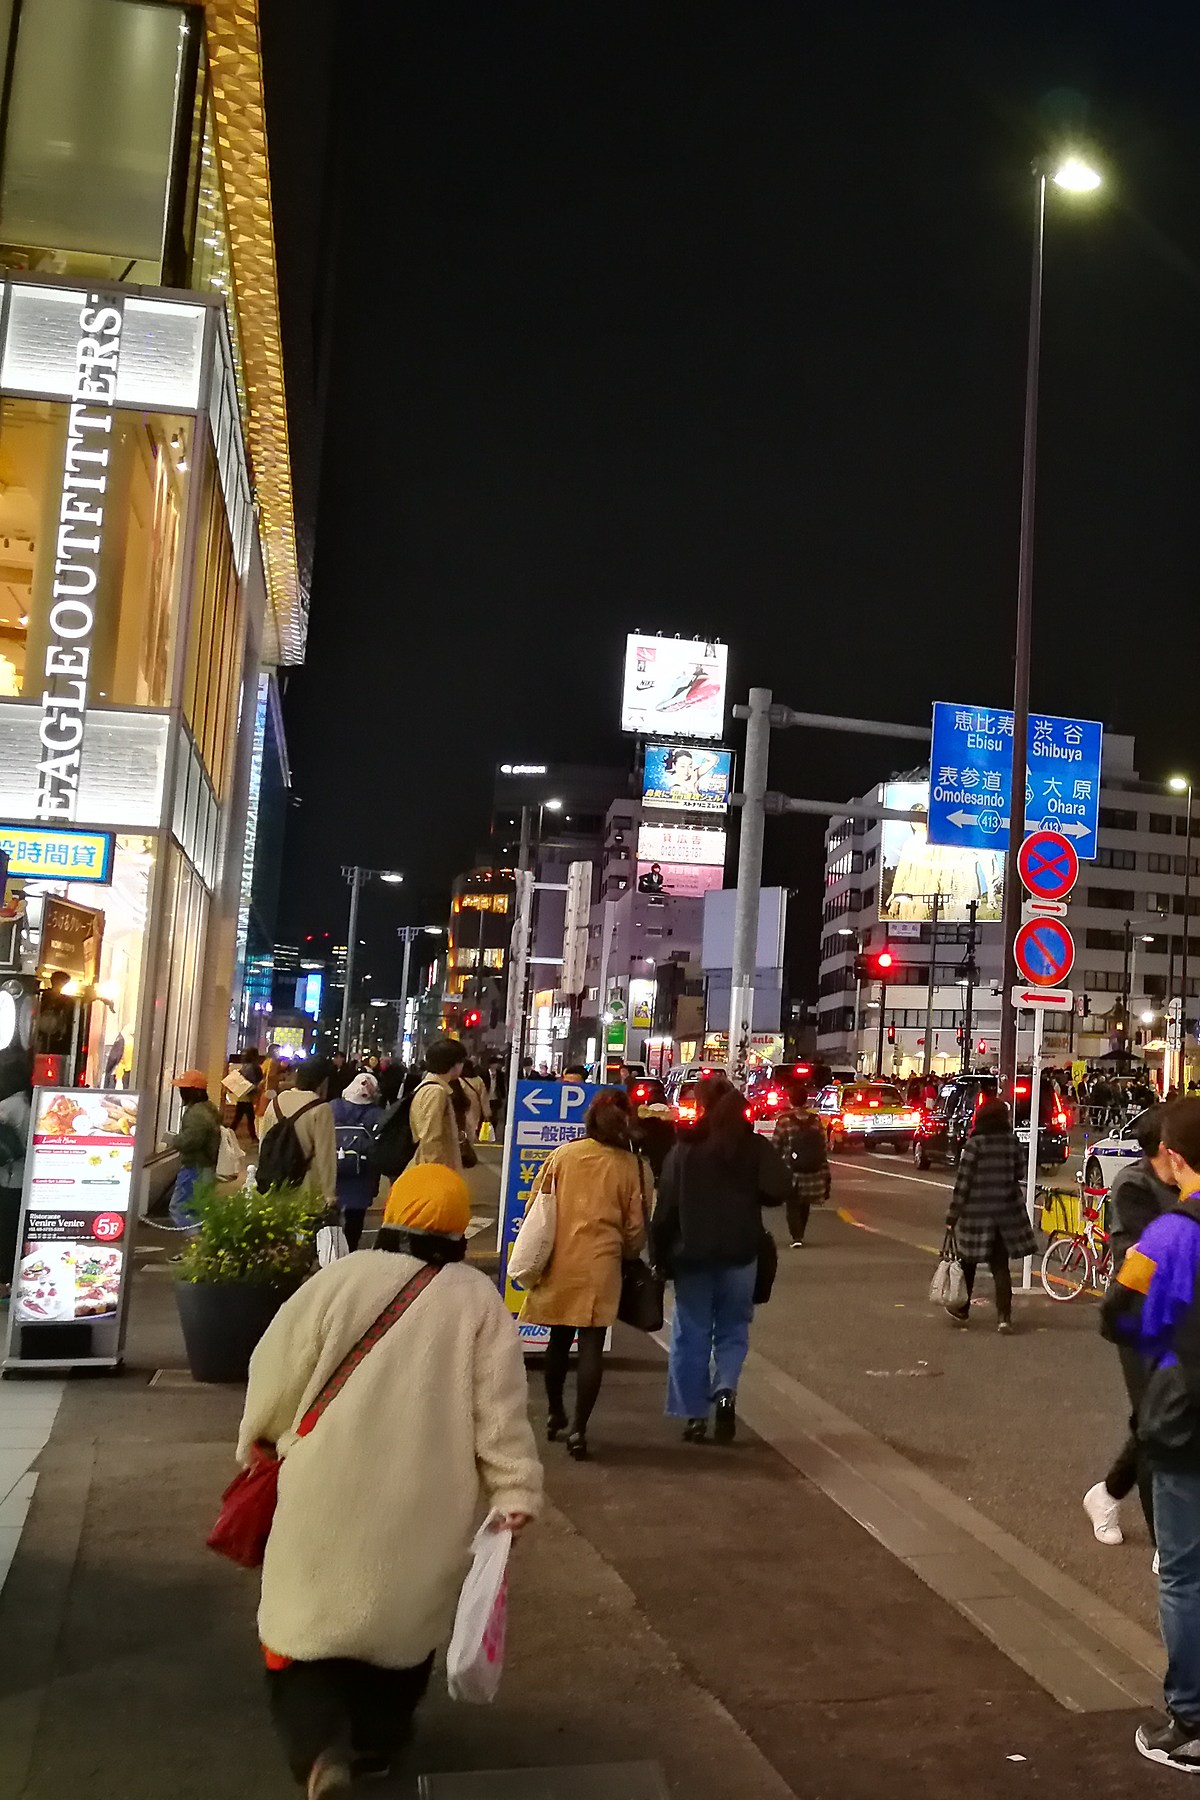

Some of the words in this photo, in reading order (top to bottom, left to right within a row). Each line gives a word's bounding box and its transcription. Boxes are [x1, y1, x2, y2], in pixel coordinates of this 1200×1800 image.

[953, 711, 1015, 737] 恵比寿
[1033, 720, 1084, 745] 渋谷
[966, 733, 1003, 752] Ebisu
[1032, 741, 1082, 763] Shibuya
[937, 766, 1002, 792] 表参道
[1042, 776, 1092, 801] 大原
[933, 786, 1005, 808] Omotesando
[1047, 798, 1086, 816] Ohara
[981, 816, 999, 828] 413
[560, 1086, 585, 1119] P
[29, 1219, 57, 1227] Venire
[58, 1219, 86, 1228] Venire
[96, 1218, 120, 1235] 5F
[518, 1325, 550, 1337] TRUS
